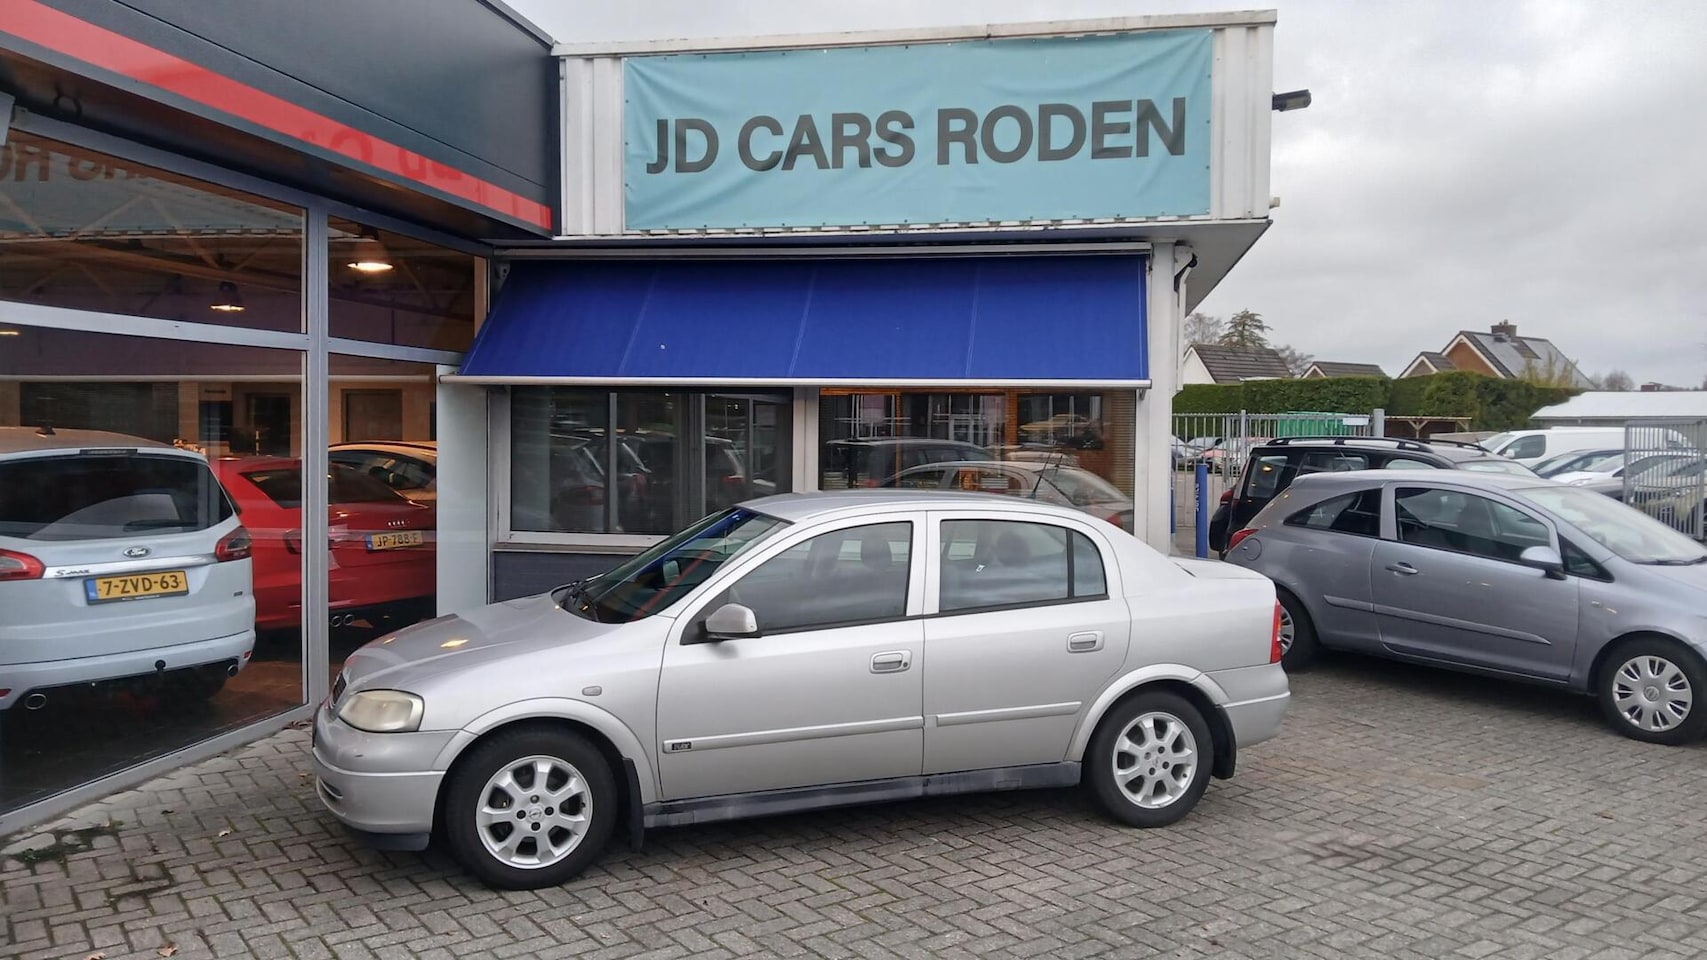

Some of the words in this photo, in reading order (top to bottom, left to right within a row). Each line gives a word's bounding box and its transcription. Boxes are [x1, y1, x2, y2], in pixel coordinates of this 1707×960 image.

[646, 118, 720, 174] JD
[737, 109, 916, 172] CARS
[936, 96, 1187, 166] RODEN
[102, 574, 180, 596] 7-ZVD-63
